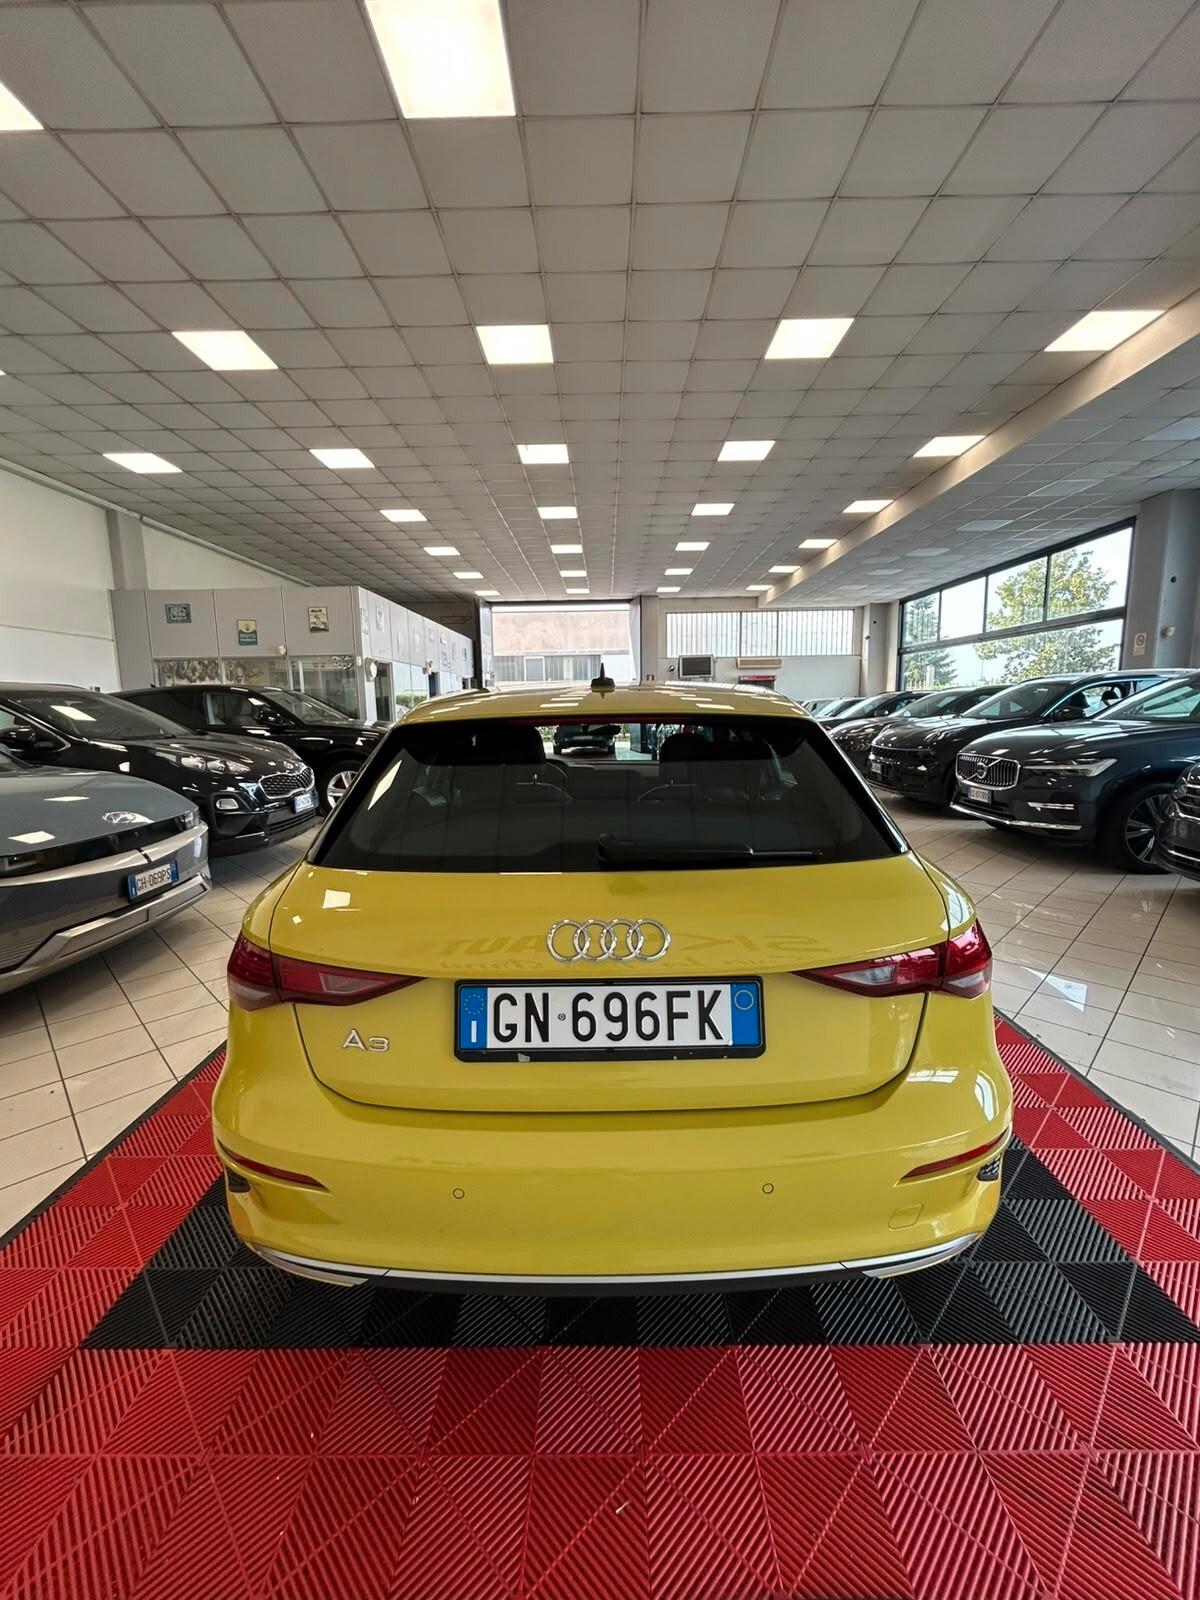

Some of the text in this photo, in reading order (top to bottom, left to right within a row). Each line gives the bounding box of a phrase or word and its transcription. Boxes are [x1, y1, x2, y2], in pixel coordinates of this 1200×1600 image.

[492, 989, 724, 1043] GN 696FK
[341, 1028, 390, 1053] A3
